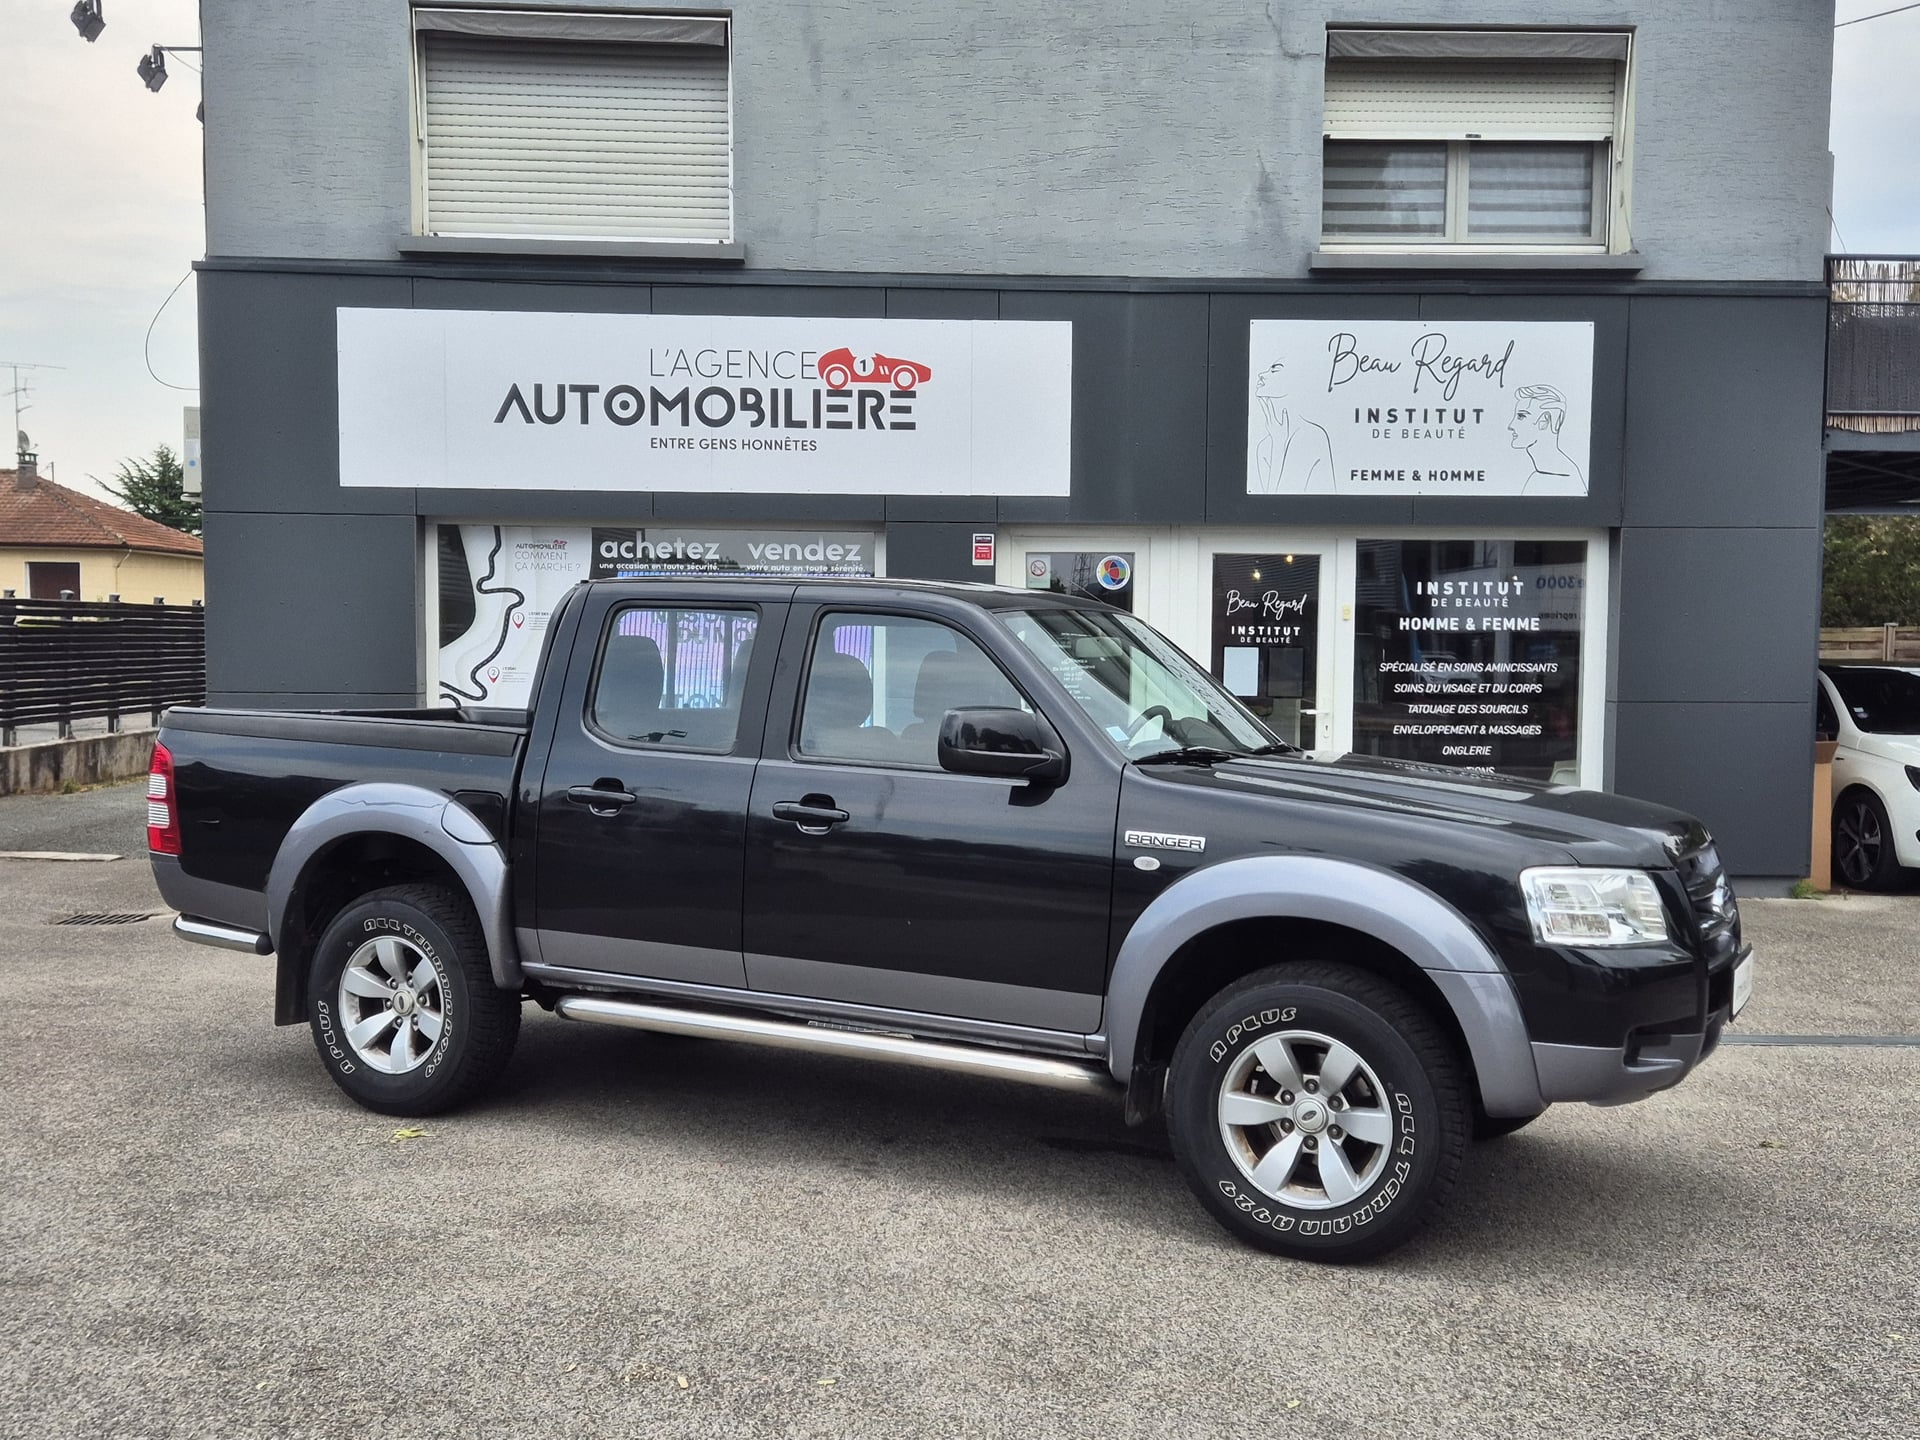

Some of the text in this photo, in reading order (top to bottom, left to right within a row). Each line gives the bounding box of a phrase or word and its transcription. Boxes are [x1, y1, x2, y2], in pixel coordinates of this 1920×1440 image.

[650, 348, 818, 380] L'AGENCE
[858, 359, 868, 373] 1
[1328, 333, 1515, 402] Beau Regard
[1354, 407, 1485, 424] INSTITUT
[1372, 425, 1466, 439] DE BEAUTÉ
[650, 436, 818, 451] ENTRE GENS HONNÊTES
[1350, 469, 1486, 482] FEMME & HOMME
[600, 530, 721, 560] achetez
[747, 536, 862, 561] vendez
[515, 551, 568, 560] COMMENT
[515, 562, 528, 572] ÇA
[530, 562, 573, 571] MARCHE
[664, 561, 684, 570] toute
[746, 563, 768, 571] votre
[805, 563, 828, 572] toute
[1416, 581, 1525, 595] INSTITUT
[1226, 589, 1308, 621] Beau Regard
[1431, 596, 1509, 608] DE BEAUTÉ
[1231, 625, 1301, 636] INSTITUT
[1399, 617, 1541, 631] HOMME & FEMME
[1256, 636, 1291, 644] BEAUTÉ
[1379, 661, 1559, 673] SPÉCIALISÉ EN SOINS AMINCISSANTS
[1393, 683, 1543, 694] SOINS DU VISAGE ET DU CORPS
[1408, 704, 1529, 714] TATOUAGE DES SOURCILS
[1393, 725, 1543, 735] ENVELOPPEMENT & MASSAGES
[1442, 745, 1492, 756] ONGLERIE
[1127, 833, 1202, 849] RANGER
[364, 917, 401, 932] ALL
[403, 923, 453, 1016] TERRAIN
[317, 1000, 356, 1074] A PLUS
[1209, 1006, 1297, 1063] A PLUS
[1395, 1092, 1415, 1156] ALL
[1298, 1161, 1411, 1236] TERRAIN
